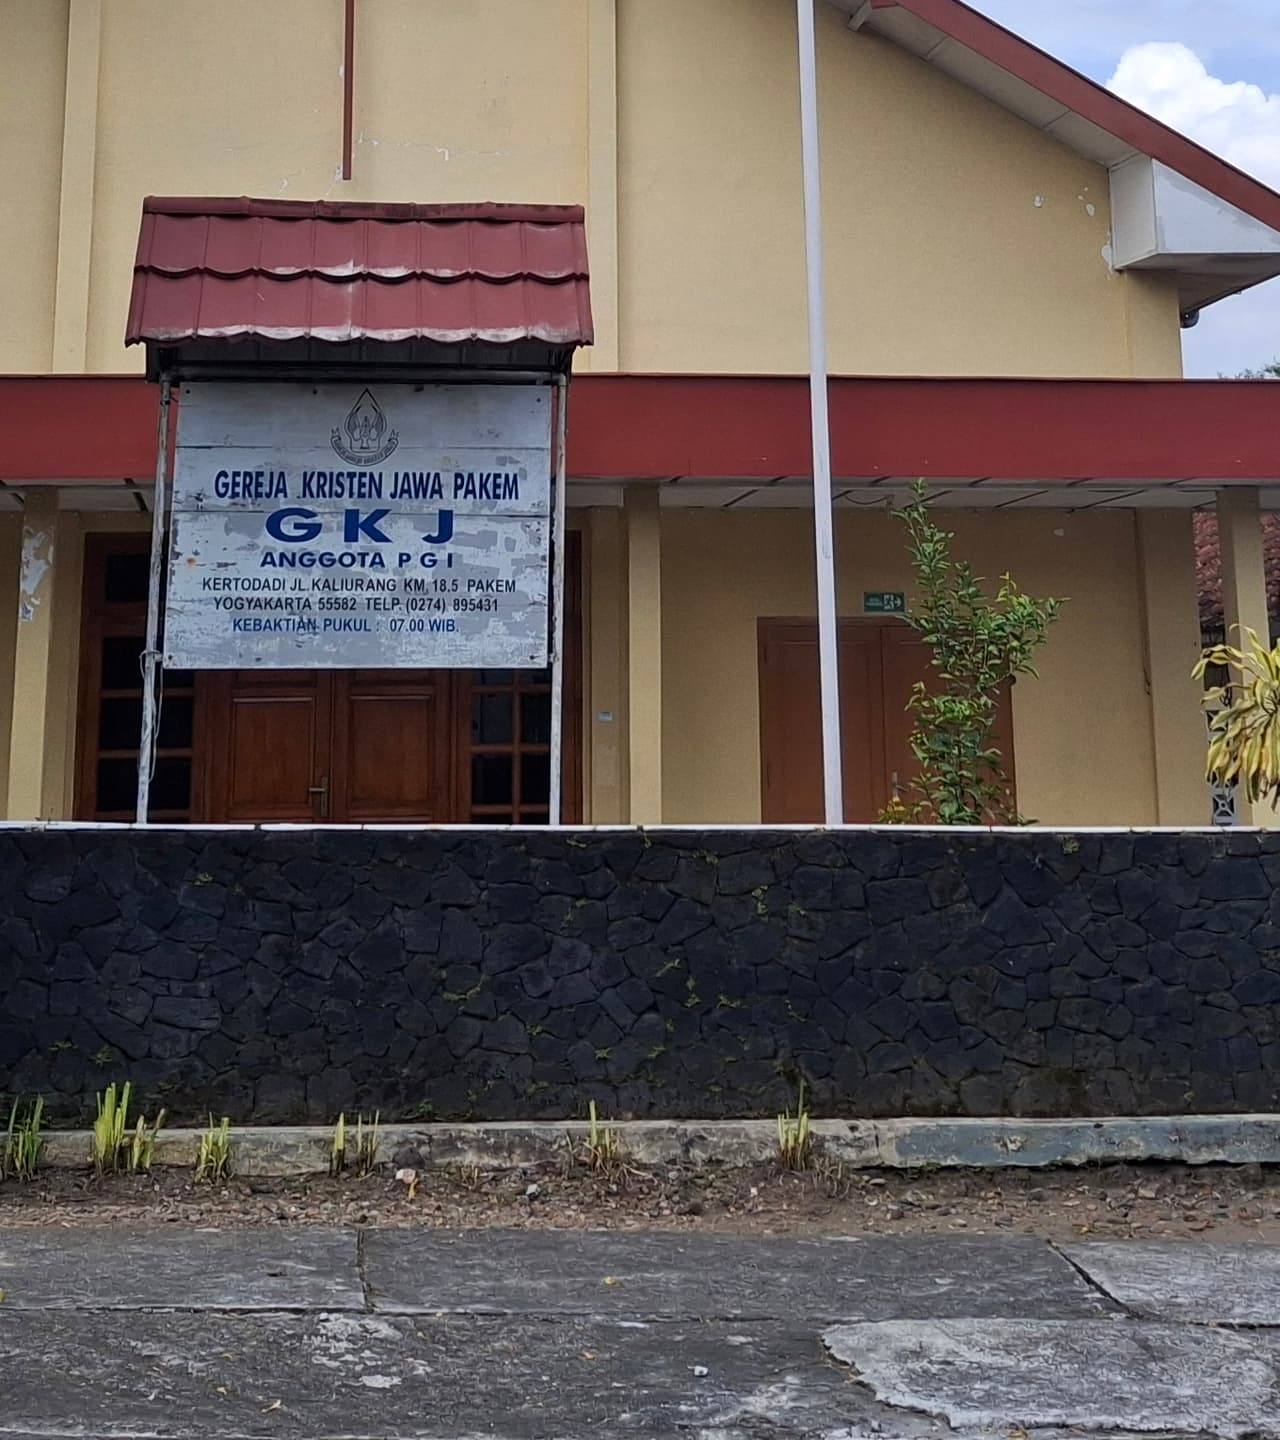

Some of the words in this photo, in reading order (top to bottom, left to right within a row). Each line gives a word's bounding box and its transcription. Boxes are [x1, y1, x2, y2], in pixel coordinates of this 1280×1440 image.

[214, 470, 288, 499] GEREJA
[302, 471, 383, 499] KRISTEN
[389, 471, 444, 500] JAWA
[453, 472, 519, 500] PAKEM
[260, 551, 385, 568] ANGGOTA
[202, 577, 286, 591] KERTODADI
[432, 579, 459, 593] 18.5
[467, 579, 516, 593] PAKEM
[214, 597, 312, 610] YOGYAKARTA
[318, 597, 357, 611] 55582
[365, 597, 402, 611] TELP.
[406, 597, 446, 614] (0274)
[453, 598, 498, 612] 895431
[233, 618, 317, 632] KEBAKTIAN
[323, 618, 371, 632] PUKUL
[389, 618, 425, 632] 07.00
[428, 619, 460, 633] WIB.
